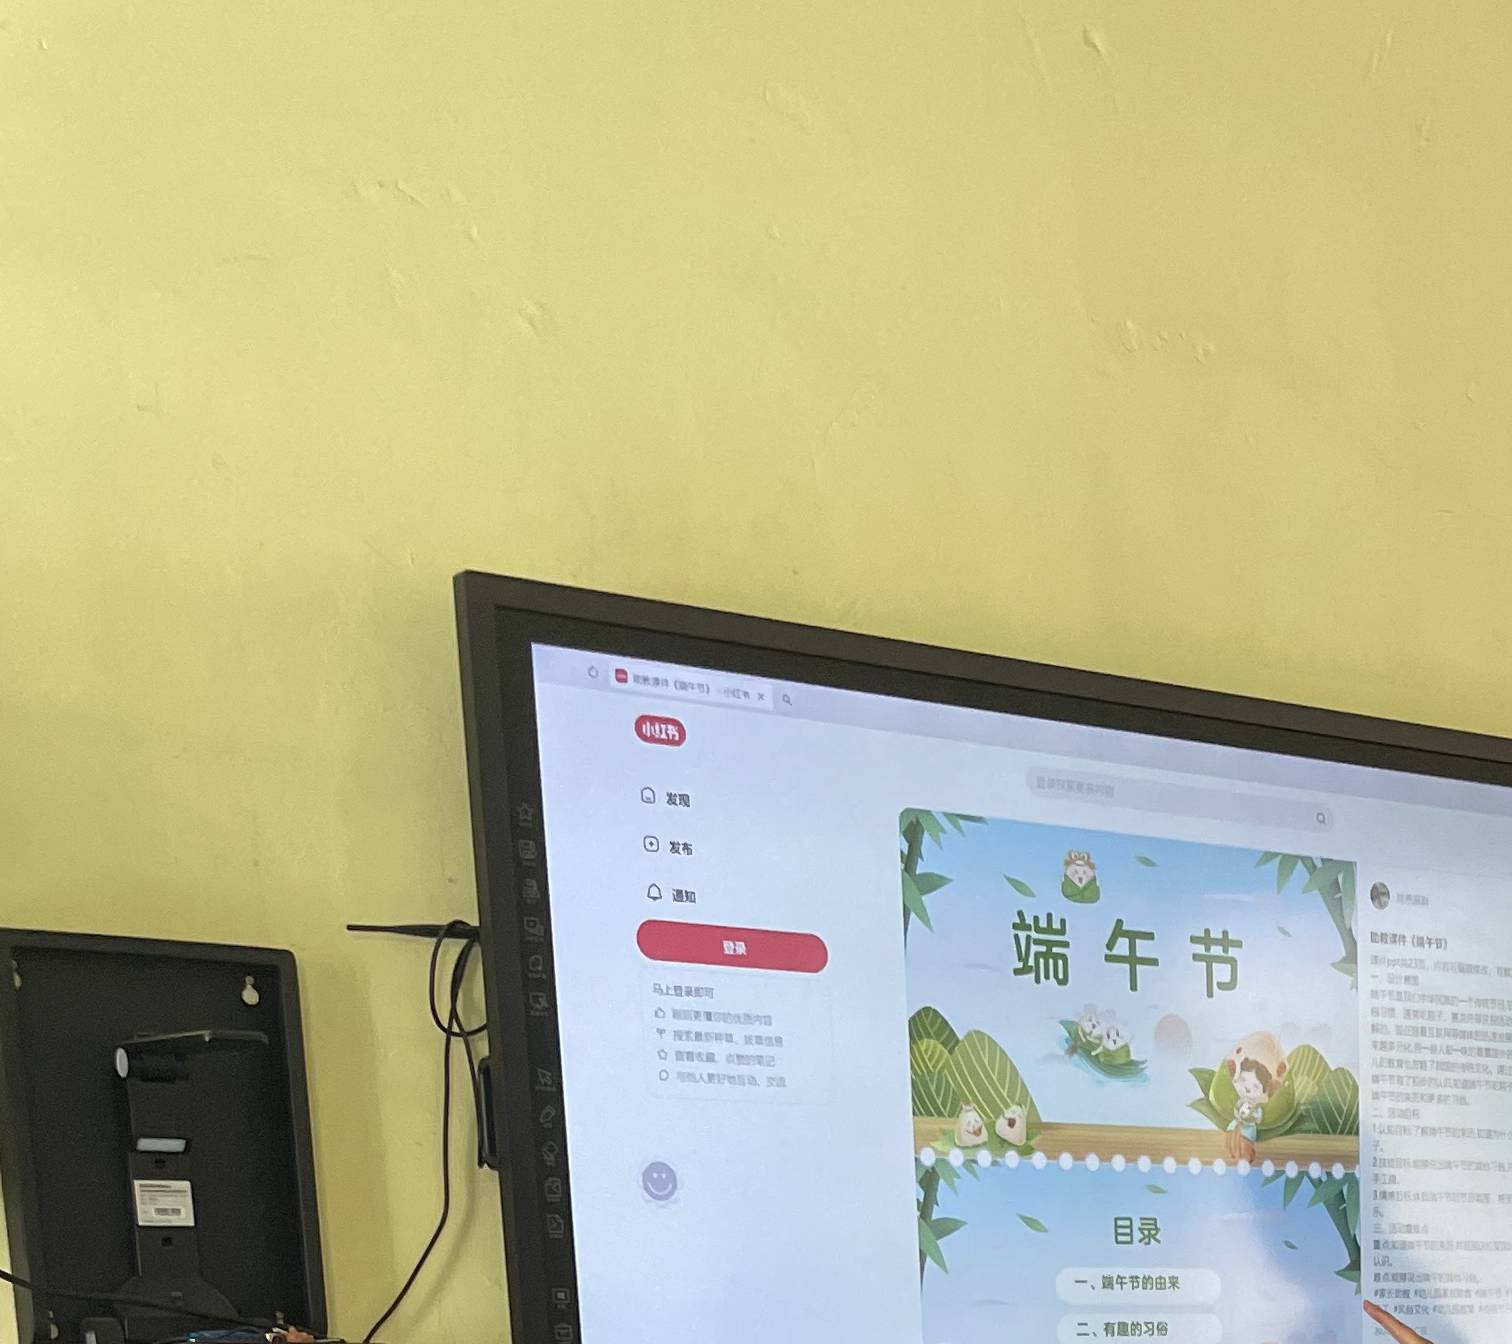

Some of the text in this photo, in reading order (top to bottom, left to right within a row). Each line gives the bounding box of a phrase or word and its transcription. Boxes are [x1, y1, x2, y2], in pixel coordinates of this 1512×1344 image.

[642, 721, 679, 741] 小红书
[666, 792, 691, 807] 发现
[669, 841, 693, 856] 发布
[672, 888, 696, 903] 通知
[722, 940, 747, 956] 登录
[1011, 909, 1244, 999] 端午节
[1112, 1216, 1161, 1246] 目录
[1074, 1273, 1181, 1293] 一、端午节的由来
[1076, 1320, 1169, 1339] 二、有趣的习俗
